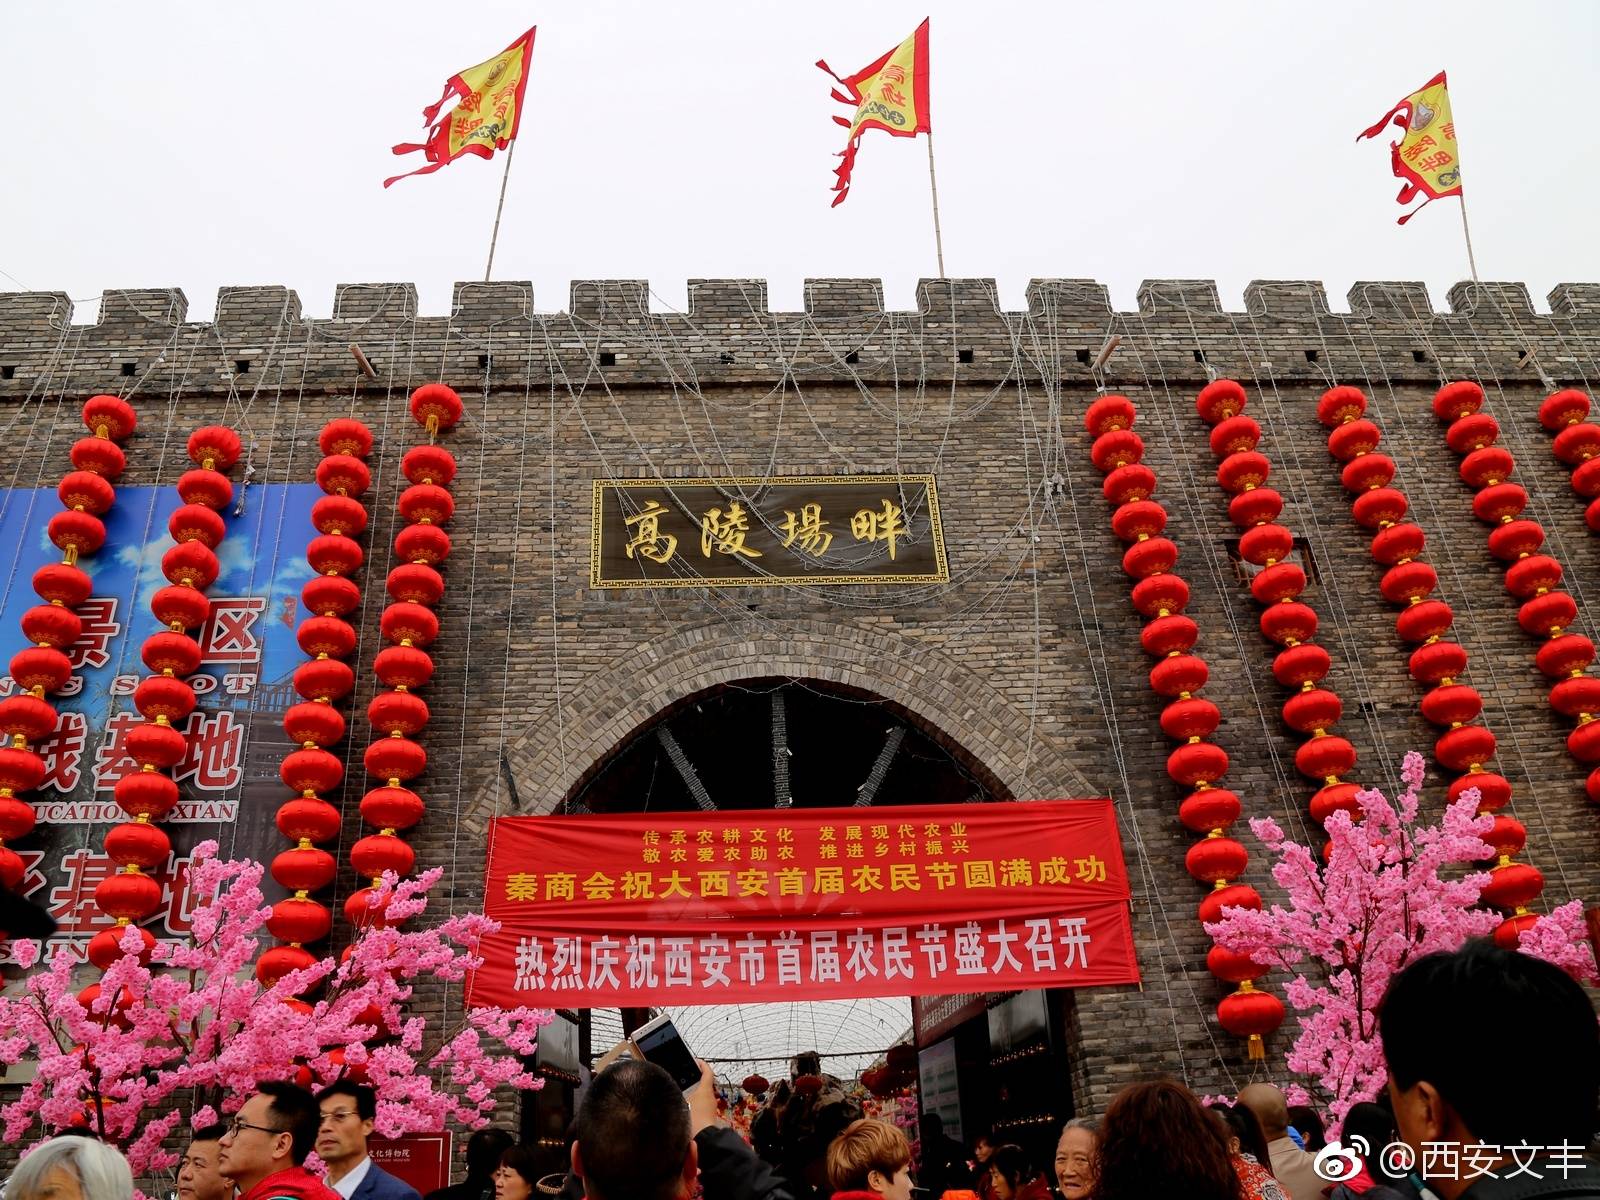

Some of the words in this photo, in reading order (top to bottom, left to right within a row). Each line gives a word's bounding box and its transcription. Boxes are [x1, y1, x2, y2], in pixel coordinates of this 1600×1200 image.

[625, 499, 907, 563] 高陵場畔
[112, 678, 256, 694] SOT
[642, 828, 794, 847] 传承农耕文化
[819, 822, 968, 842] 发展现代农业
[642, 845, 796, 865] 敬农爱农助农
[819, 840, 970, 860] 推进乡村振兴
[505, 855, 1107, 902] 秦商会祝大西安首届农民节圆满成功
[513, 917, 1092, 991] 热烈庆祝西安市首届农民节盛大召开
